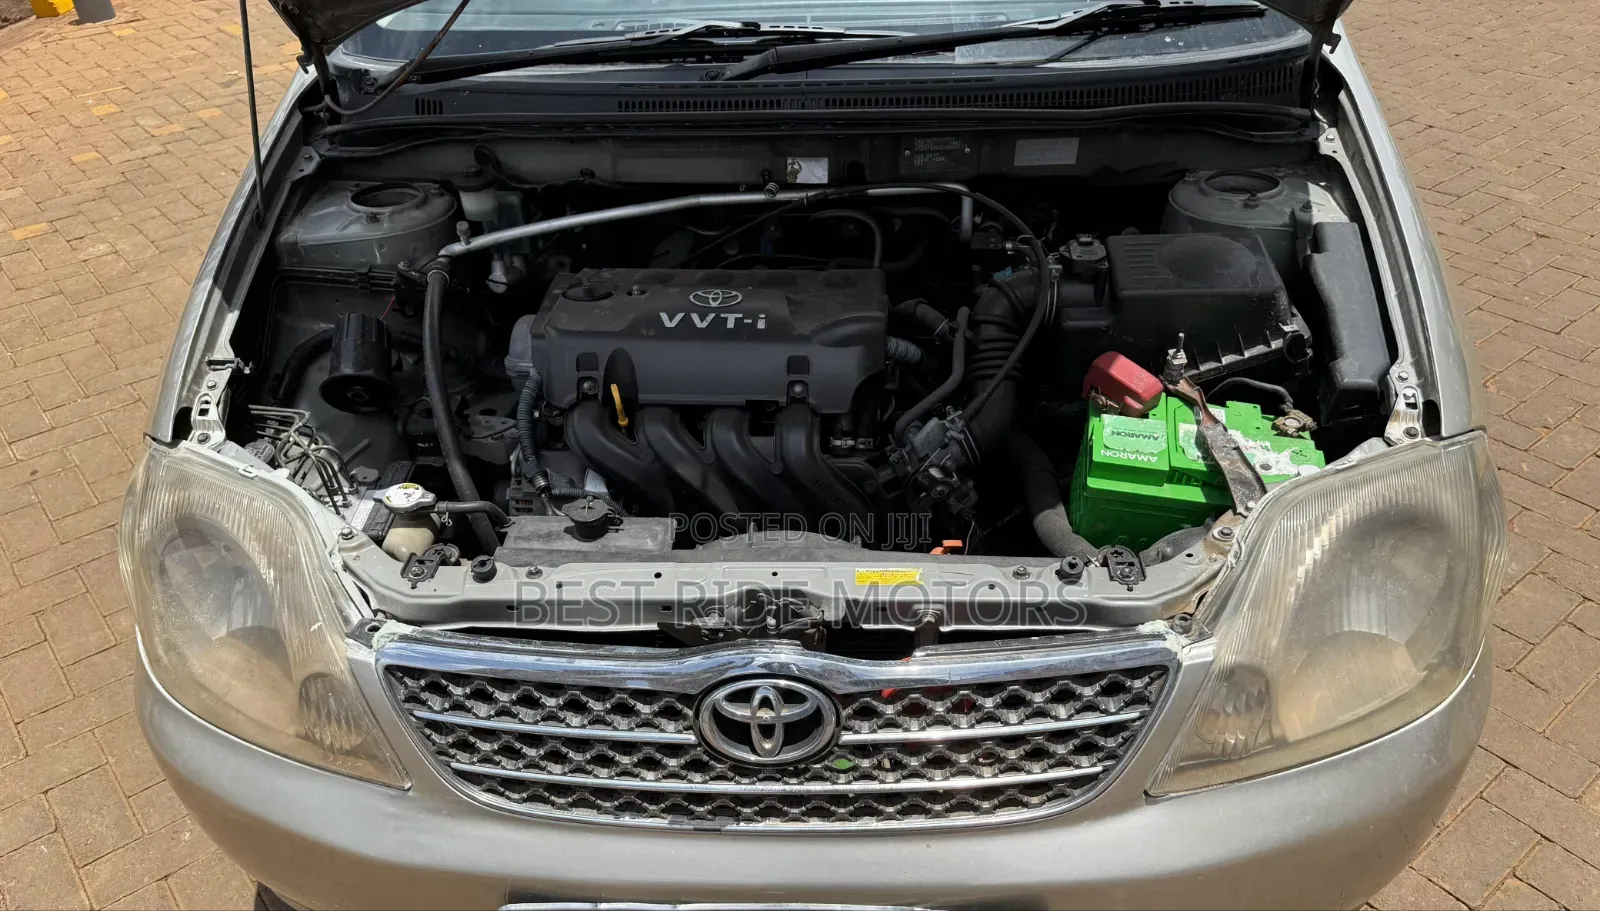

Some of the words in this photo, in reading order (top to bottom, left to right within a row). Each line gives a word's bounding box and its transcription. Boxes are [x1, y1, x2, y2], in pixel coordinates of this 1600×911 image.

[659, 311, 767, 329] VVT-i
[1111, 430, 1160, 441] AMARON
[1101, 449, 1158, 463] AMARON
